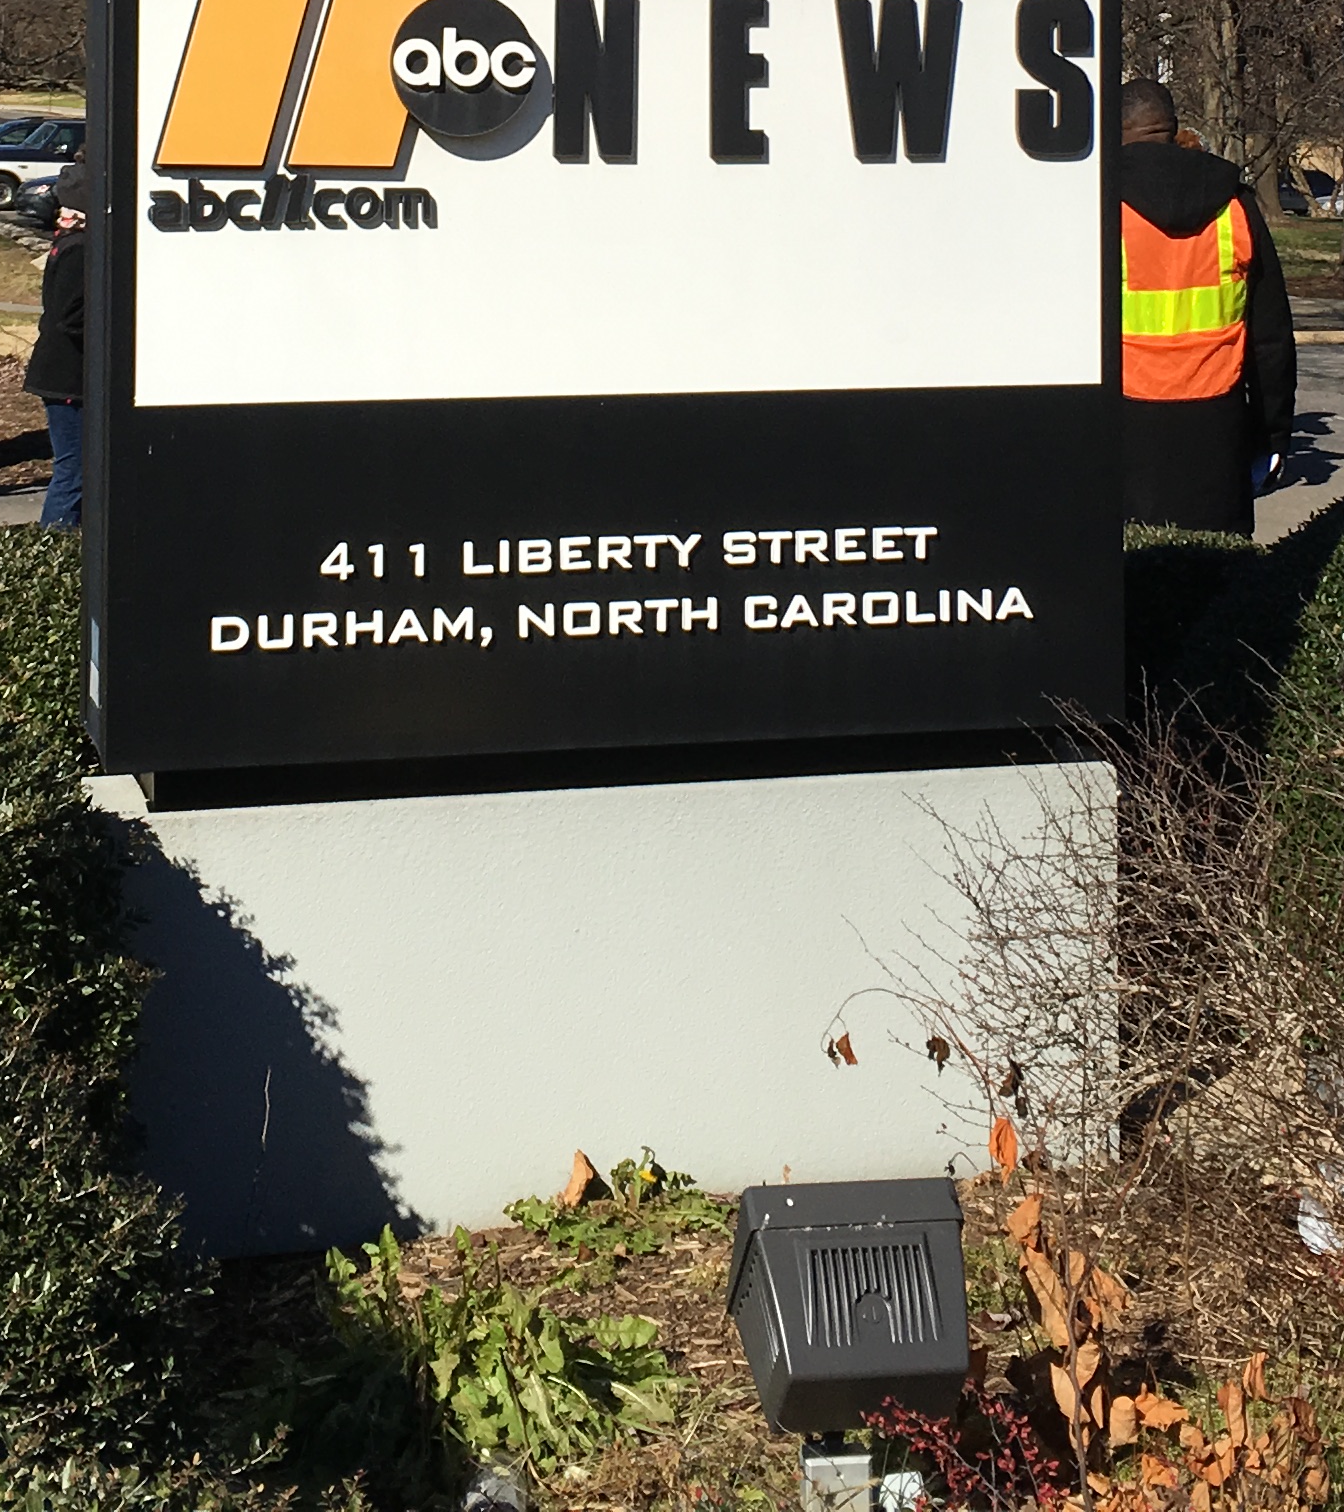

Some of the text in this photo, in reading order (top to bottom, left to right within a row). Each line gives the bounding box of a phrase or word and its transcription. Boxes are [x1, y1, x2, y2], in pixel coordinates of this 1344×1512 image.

[393, 27, 536, 88] abc
[320, 526, 939, 581] 411 LIBERTY STREET
[211, 587, 1035, 653] DURHAM, NORTH CAROLINA
